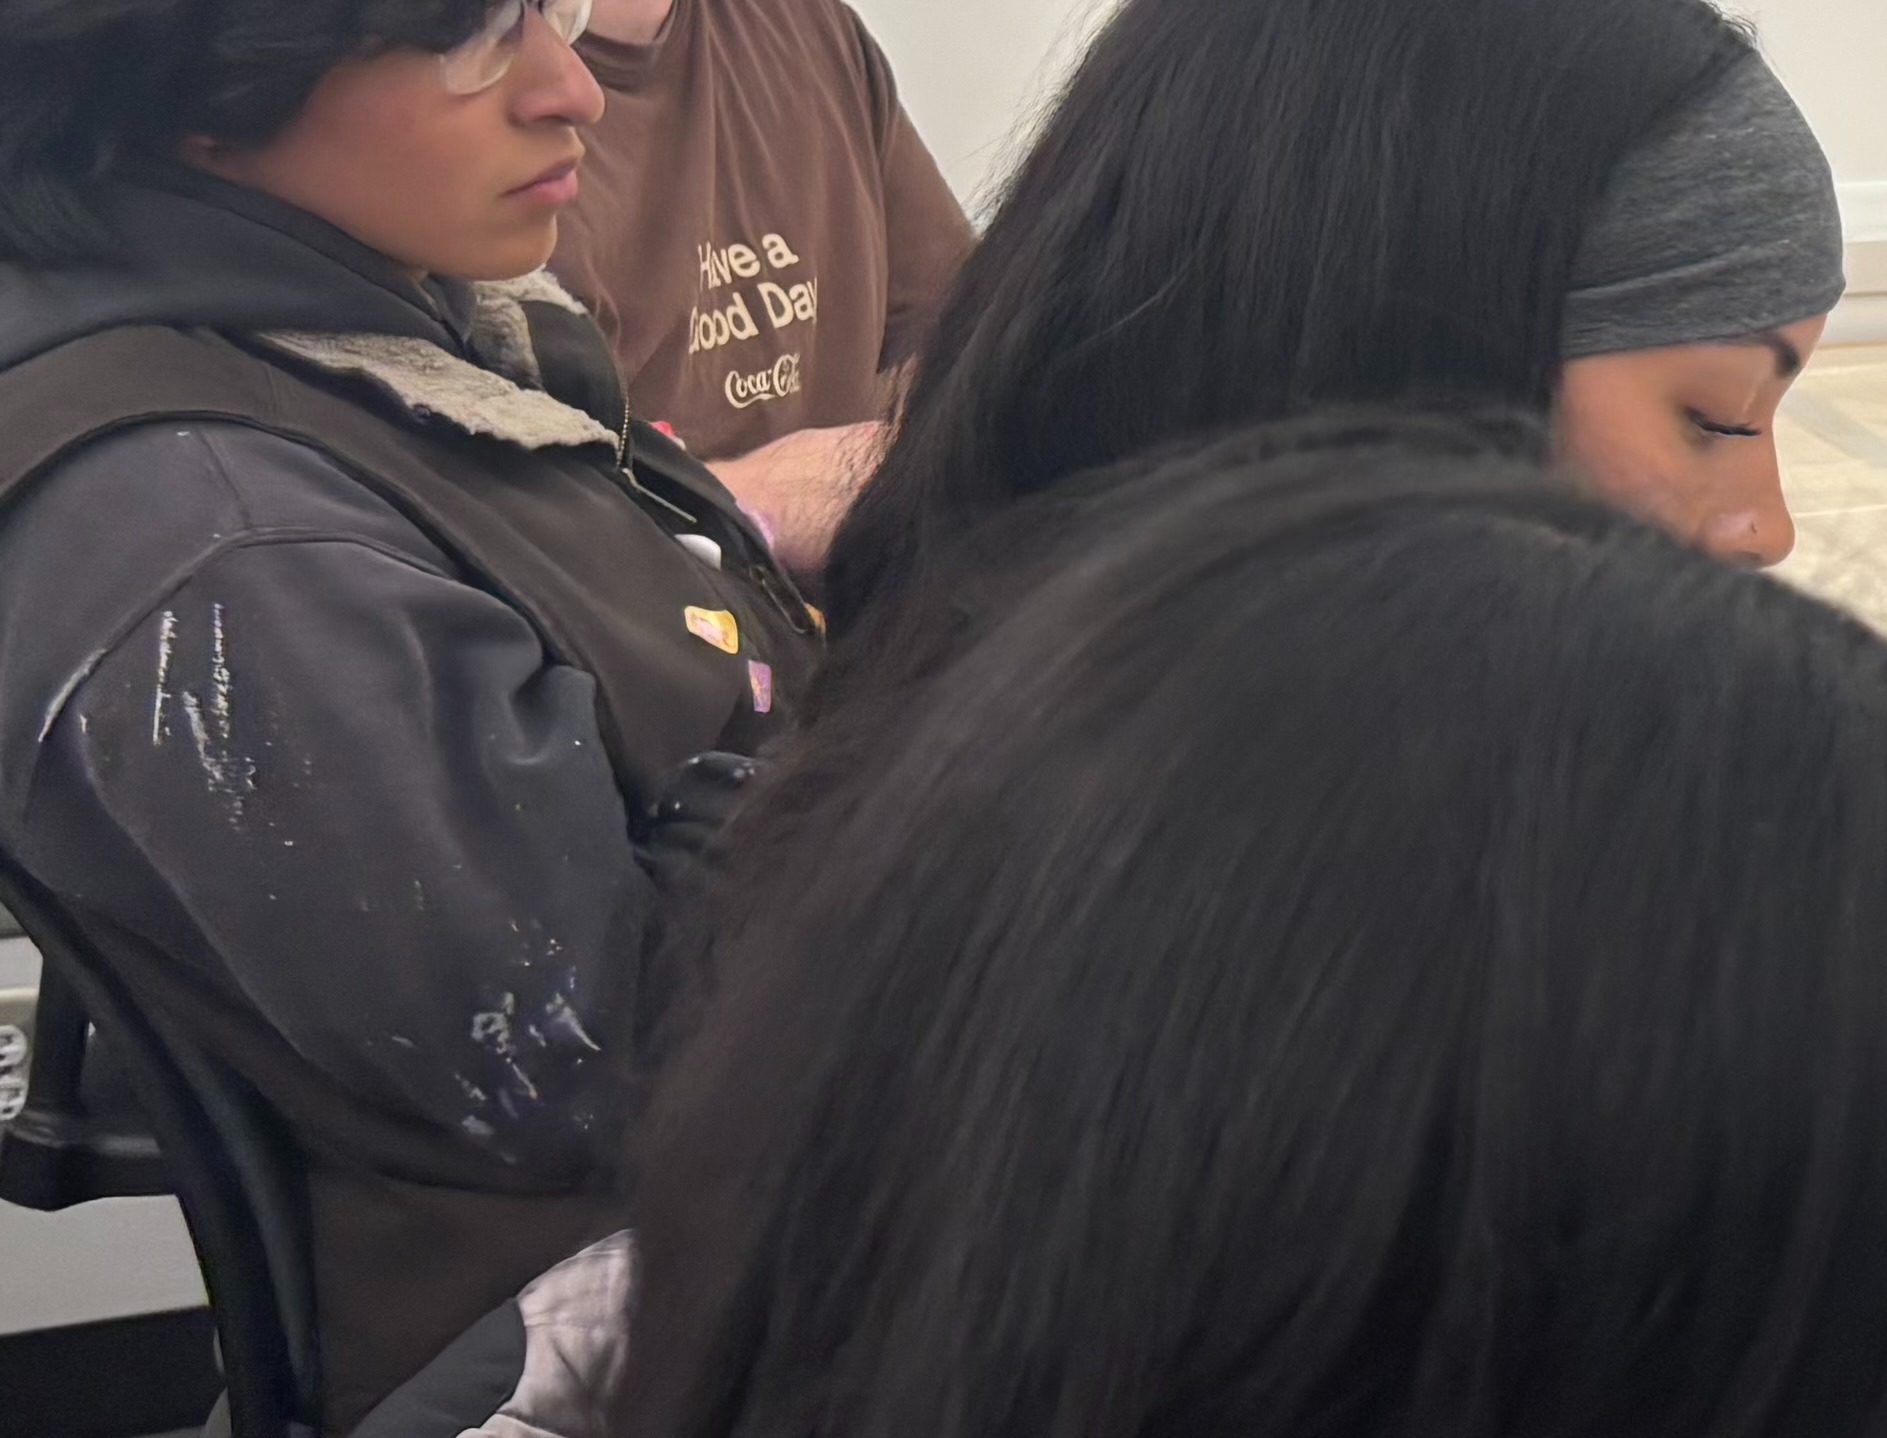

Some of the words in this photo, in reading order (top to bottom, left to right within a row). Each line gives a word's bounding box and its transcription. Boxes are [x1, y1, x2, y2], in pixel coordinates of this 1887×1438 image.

[762, 233, 799, 268] a
[757, 276, 818, 328] Day
[725, 353, 800, 409] Coca-C
